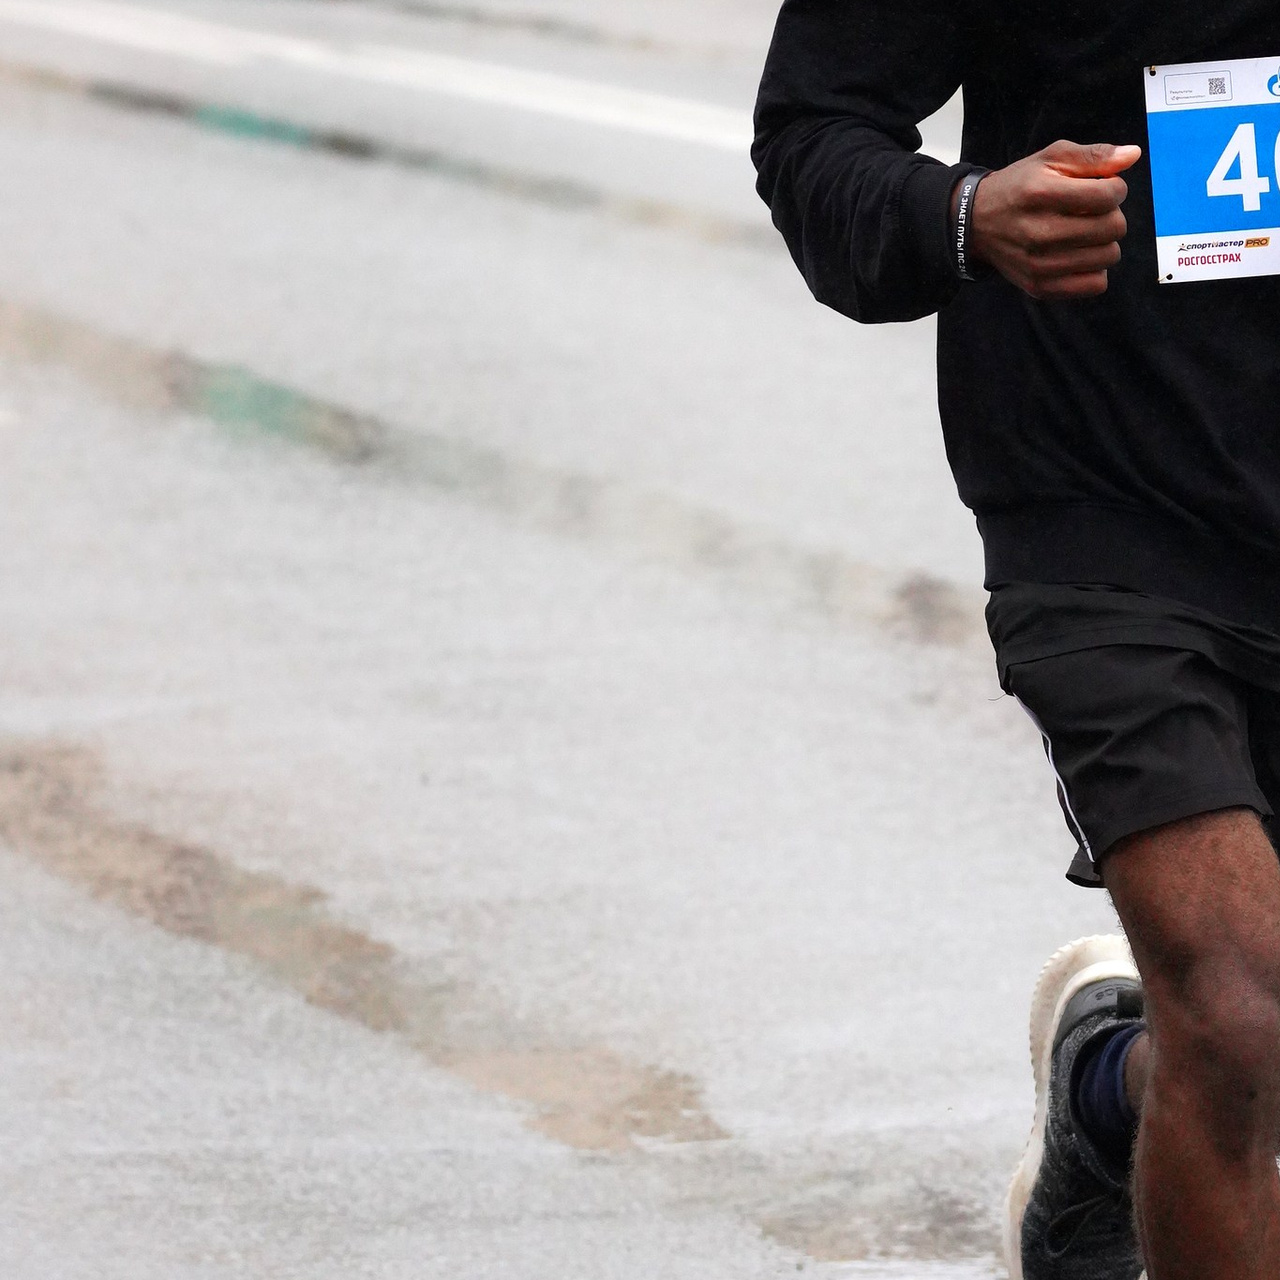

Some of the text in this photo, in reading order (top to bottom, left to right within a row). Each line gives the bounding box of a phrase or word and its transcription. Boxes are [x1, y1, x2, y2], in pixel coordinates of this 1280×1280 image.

[963, 185, 971, 196] ОН
[959, 198, 968, 225] ЗНАЕТ
[1245, 238, 1269, 247] PRO
[1178, 253, 1241, 266] РОСГОССТРАХ
